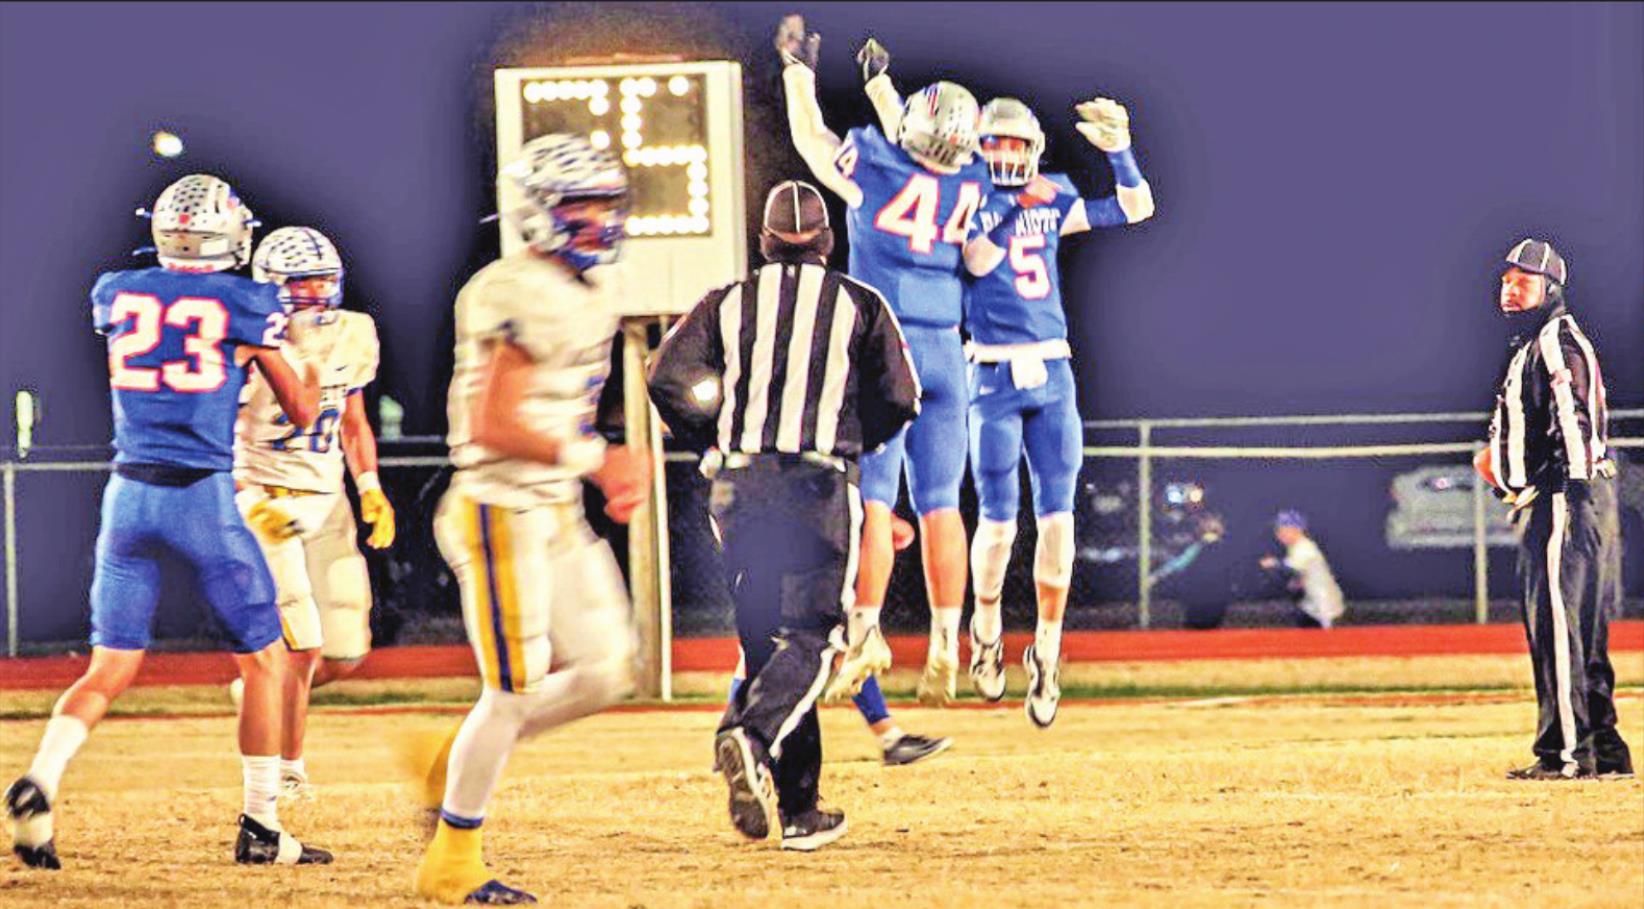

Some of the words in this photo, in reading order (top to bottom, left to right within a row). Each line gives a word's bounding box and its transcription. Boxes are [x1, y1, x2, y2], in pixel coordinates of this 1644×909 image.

[523, 76, 710, 236] 5
[873, 173, 981, 255] 44
[1008, 233, 1053, 300] 5
[108, 291, 229, 394] 23
